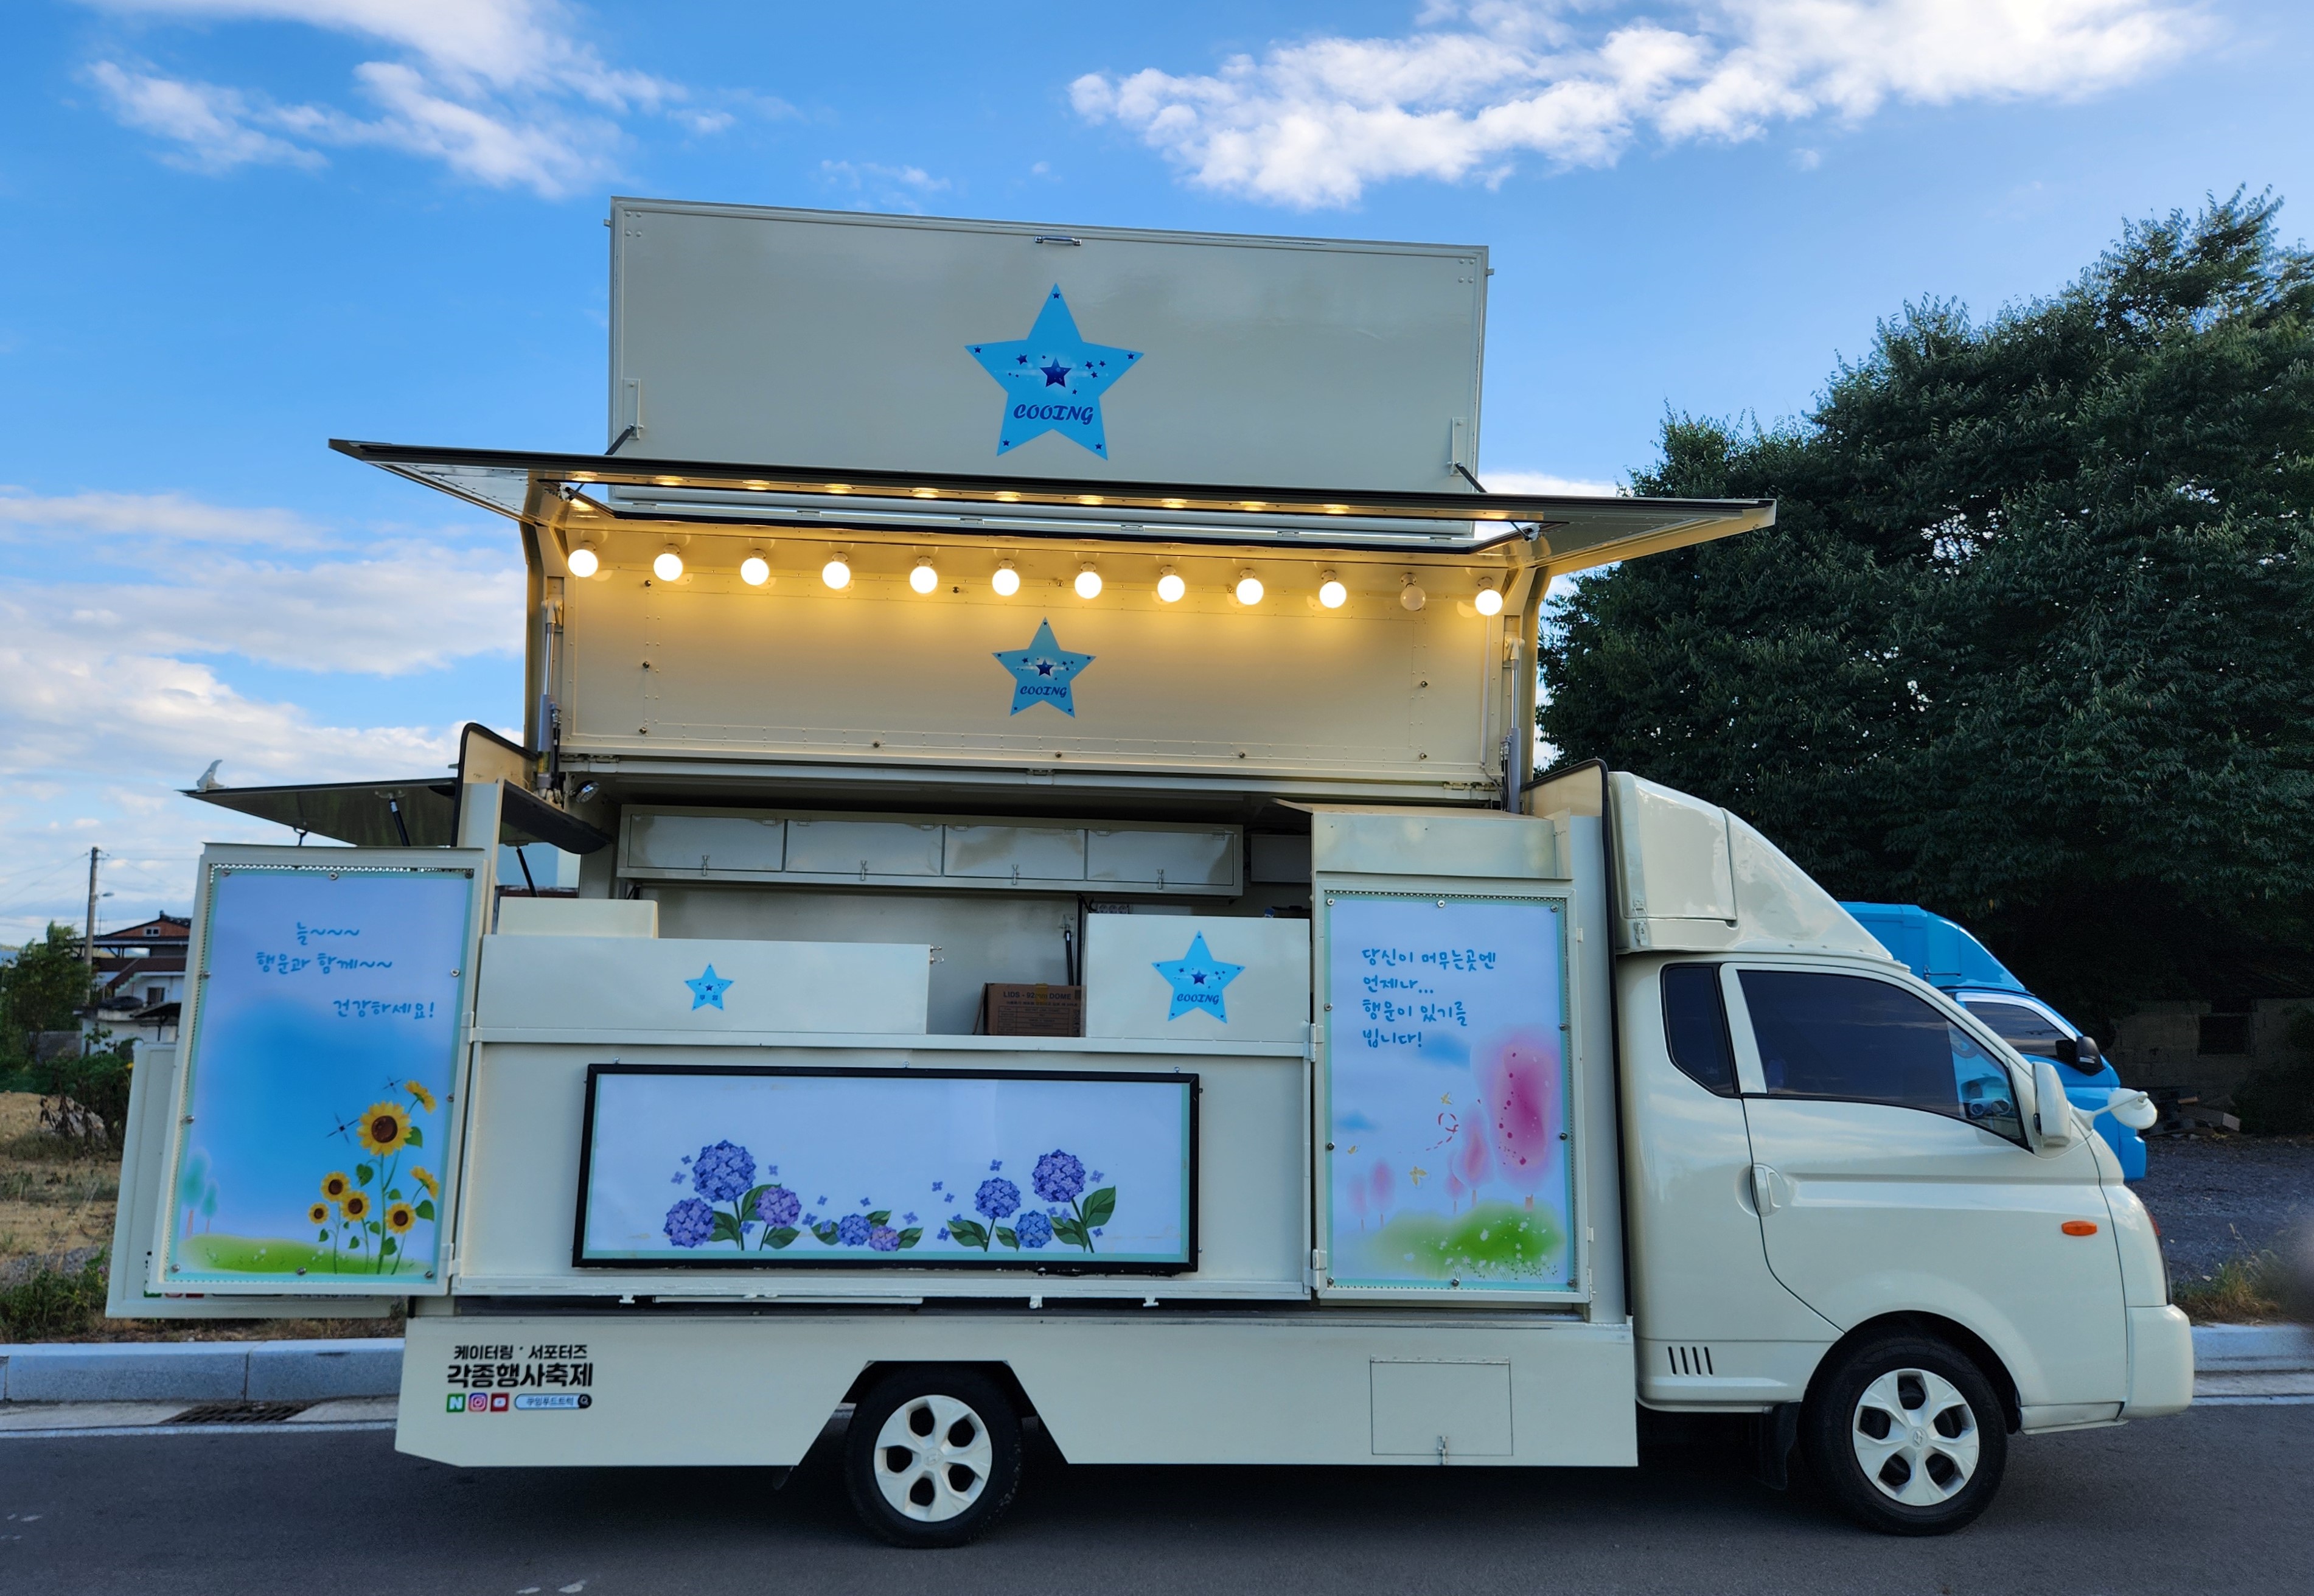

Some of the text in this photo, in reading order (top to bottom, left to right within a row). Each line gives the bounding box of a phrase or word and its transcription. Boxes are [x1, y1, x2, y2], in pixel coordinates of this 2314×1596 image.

[1012, 403, 1094, 425] COOING
[1020, 686, 1067, 698] COOING
[256, 952, 312, 974] 행운과
[1362, 948, 1496, 972] 당신이 머무는곳엔
[333, 999, 435, 1019] 건강하세요!
[1176, 993, 1219, 1005] COOING
[1362, 999, 1468, 1026] 행운이 있기를
[1362, 1028, 1422, 1048] 빕니다!
[453, 1344, 514, 1360] 케이터링
[528, 1344, 588, 1359] 서포터즈
[447, 1362, 593, 1388] 각종행사축제
